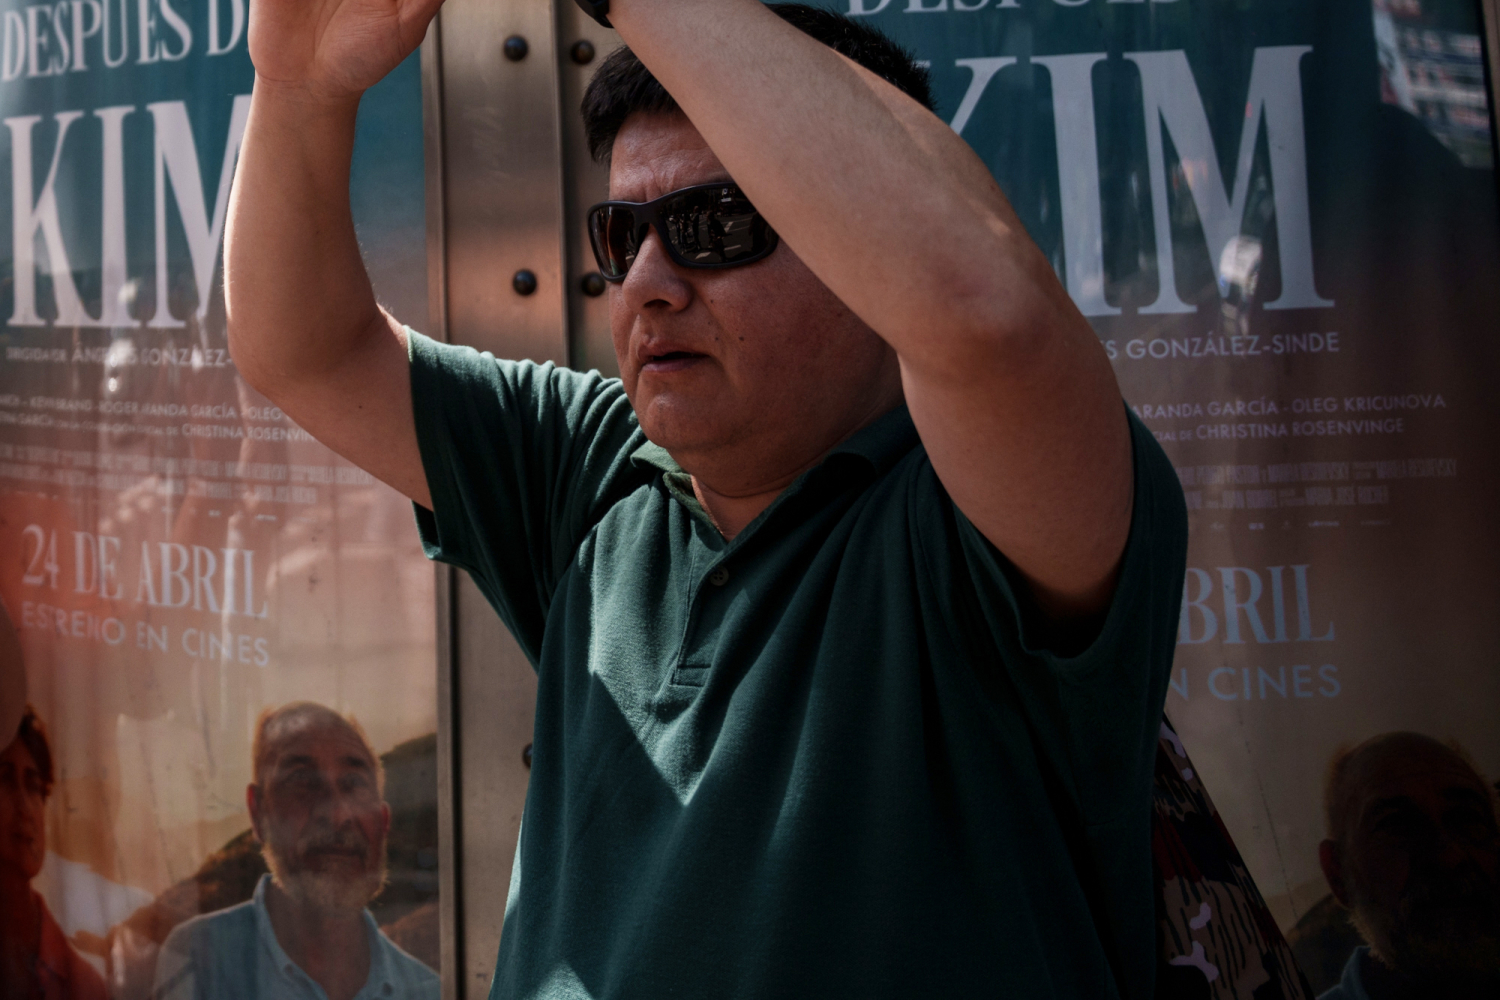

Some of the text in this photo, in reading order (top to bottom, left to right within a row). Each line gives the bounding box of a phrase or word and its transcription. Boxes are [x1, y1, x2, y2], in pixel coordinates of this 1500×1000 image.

[1125, 330, 1341, 360] GONZÁLEZ-SINDE
[1207, 395, 1279, 417] GARCÍA
[1293, 396, 1338, 414] OLEG
[1343, 393, 1447, 413] KRICUNOVA
[1196, 421, 1289, 441] CHRISTINA
[1293, 417, 1405, 438] ROSENVINGE
[21, 523, 269, 619] 24 DE ABRIL
[137, 618, 168, 655] EN
[182, 627, 270, 668] CINES
[1207, 663, 1342, 701] CINES
